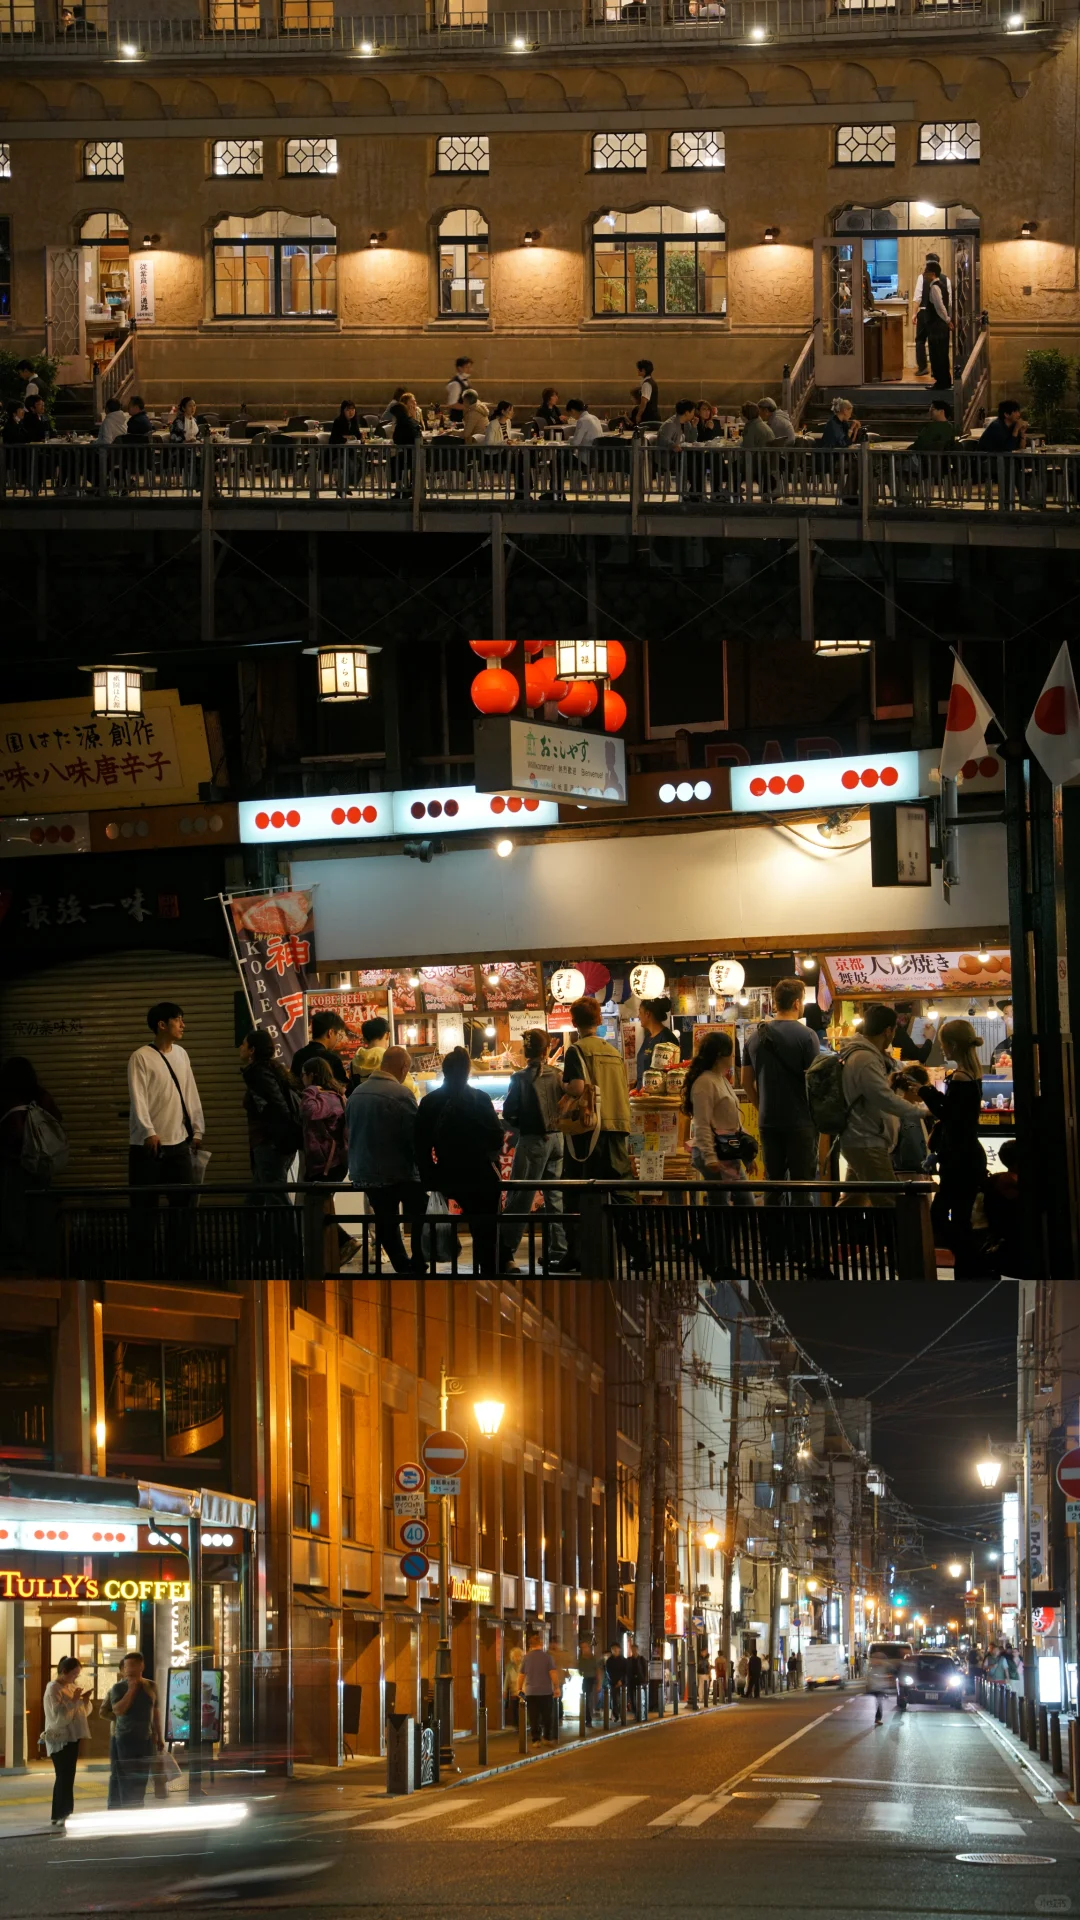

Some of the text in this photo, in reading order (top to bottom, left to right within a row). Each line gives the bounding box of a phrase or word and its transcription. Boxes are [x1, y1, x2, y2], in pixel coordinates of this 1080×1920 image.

[0, 720, 155, 755] 園はた源創作
[0, 752, 171, 792] 味・八味唐辛子
[835, 957, 865, 971] 京都
[556, 973, 564, 1000] ラーメン
[633, 968, 643, 997] 神戸牛
[838, 972, 870, 985] 舞妓
[246, 940, 272, 1013] KOBE
[266, 1024, 285, 1068] BE
[310, 993, 367, 1007] KOBE BEEF
[406, 1528, 423, 1541] 40
